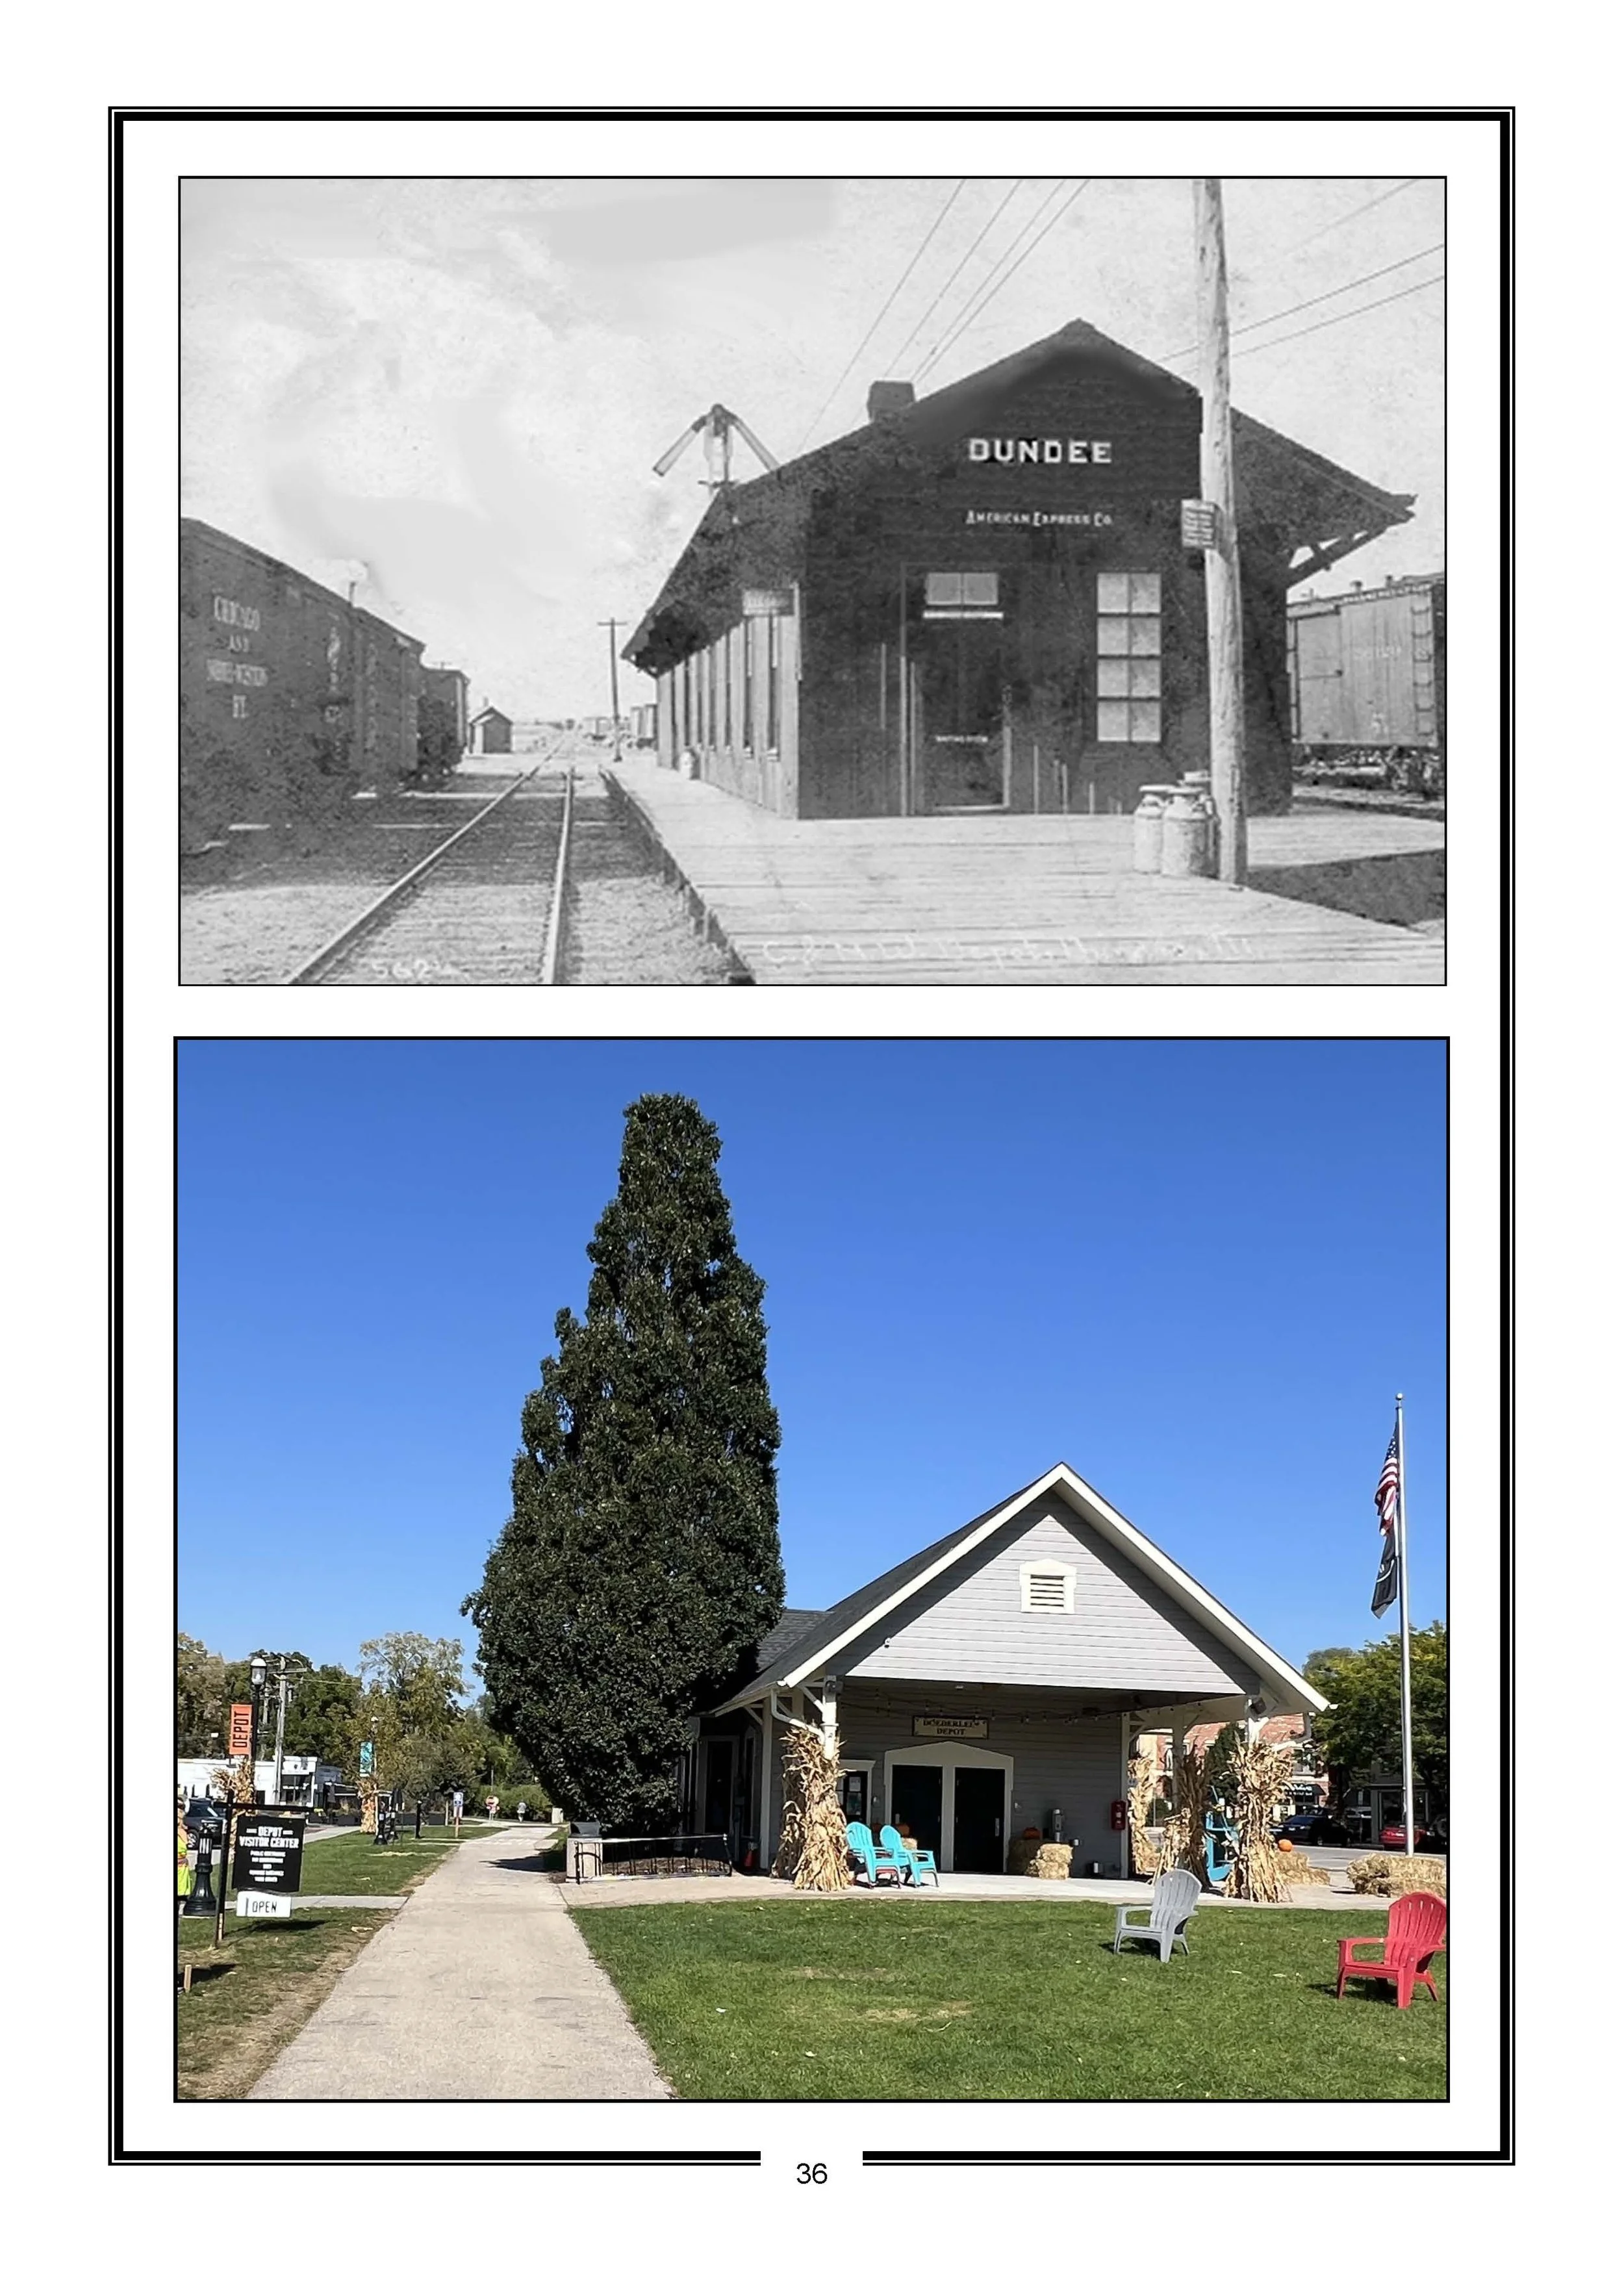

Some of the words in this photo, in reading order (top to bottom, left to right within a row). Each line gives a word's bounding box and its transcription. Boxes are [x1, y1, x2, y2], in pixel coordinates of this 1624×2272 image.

[969, 437, 1111, 463] DUNDEE
[233, 1711, 249, 1748] DEPOT
[936, 1728, 965, 1736] DEPOT
[258, 1826, 283, 1837] DEPOT
[239, 1836, 270, 1847] VISITOR
[270, 1837, 299, 1849] CENTER
[252, 1900, 277, 1913] OPEN
